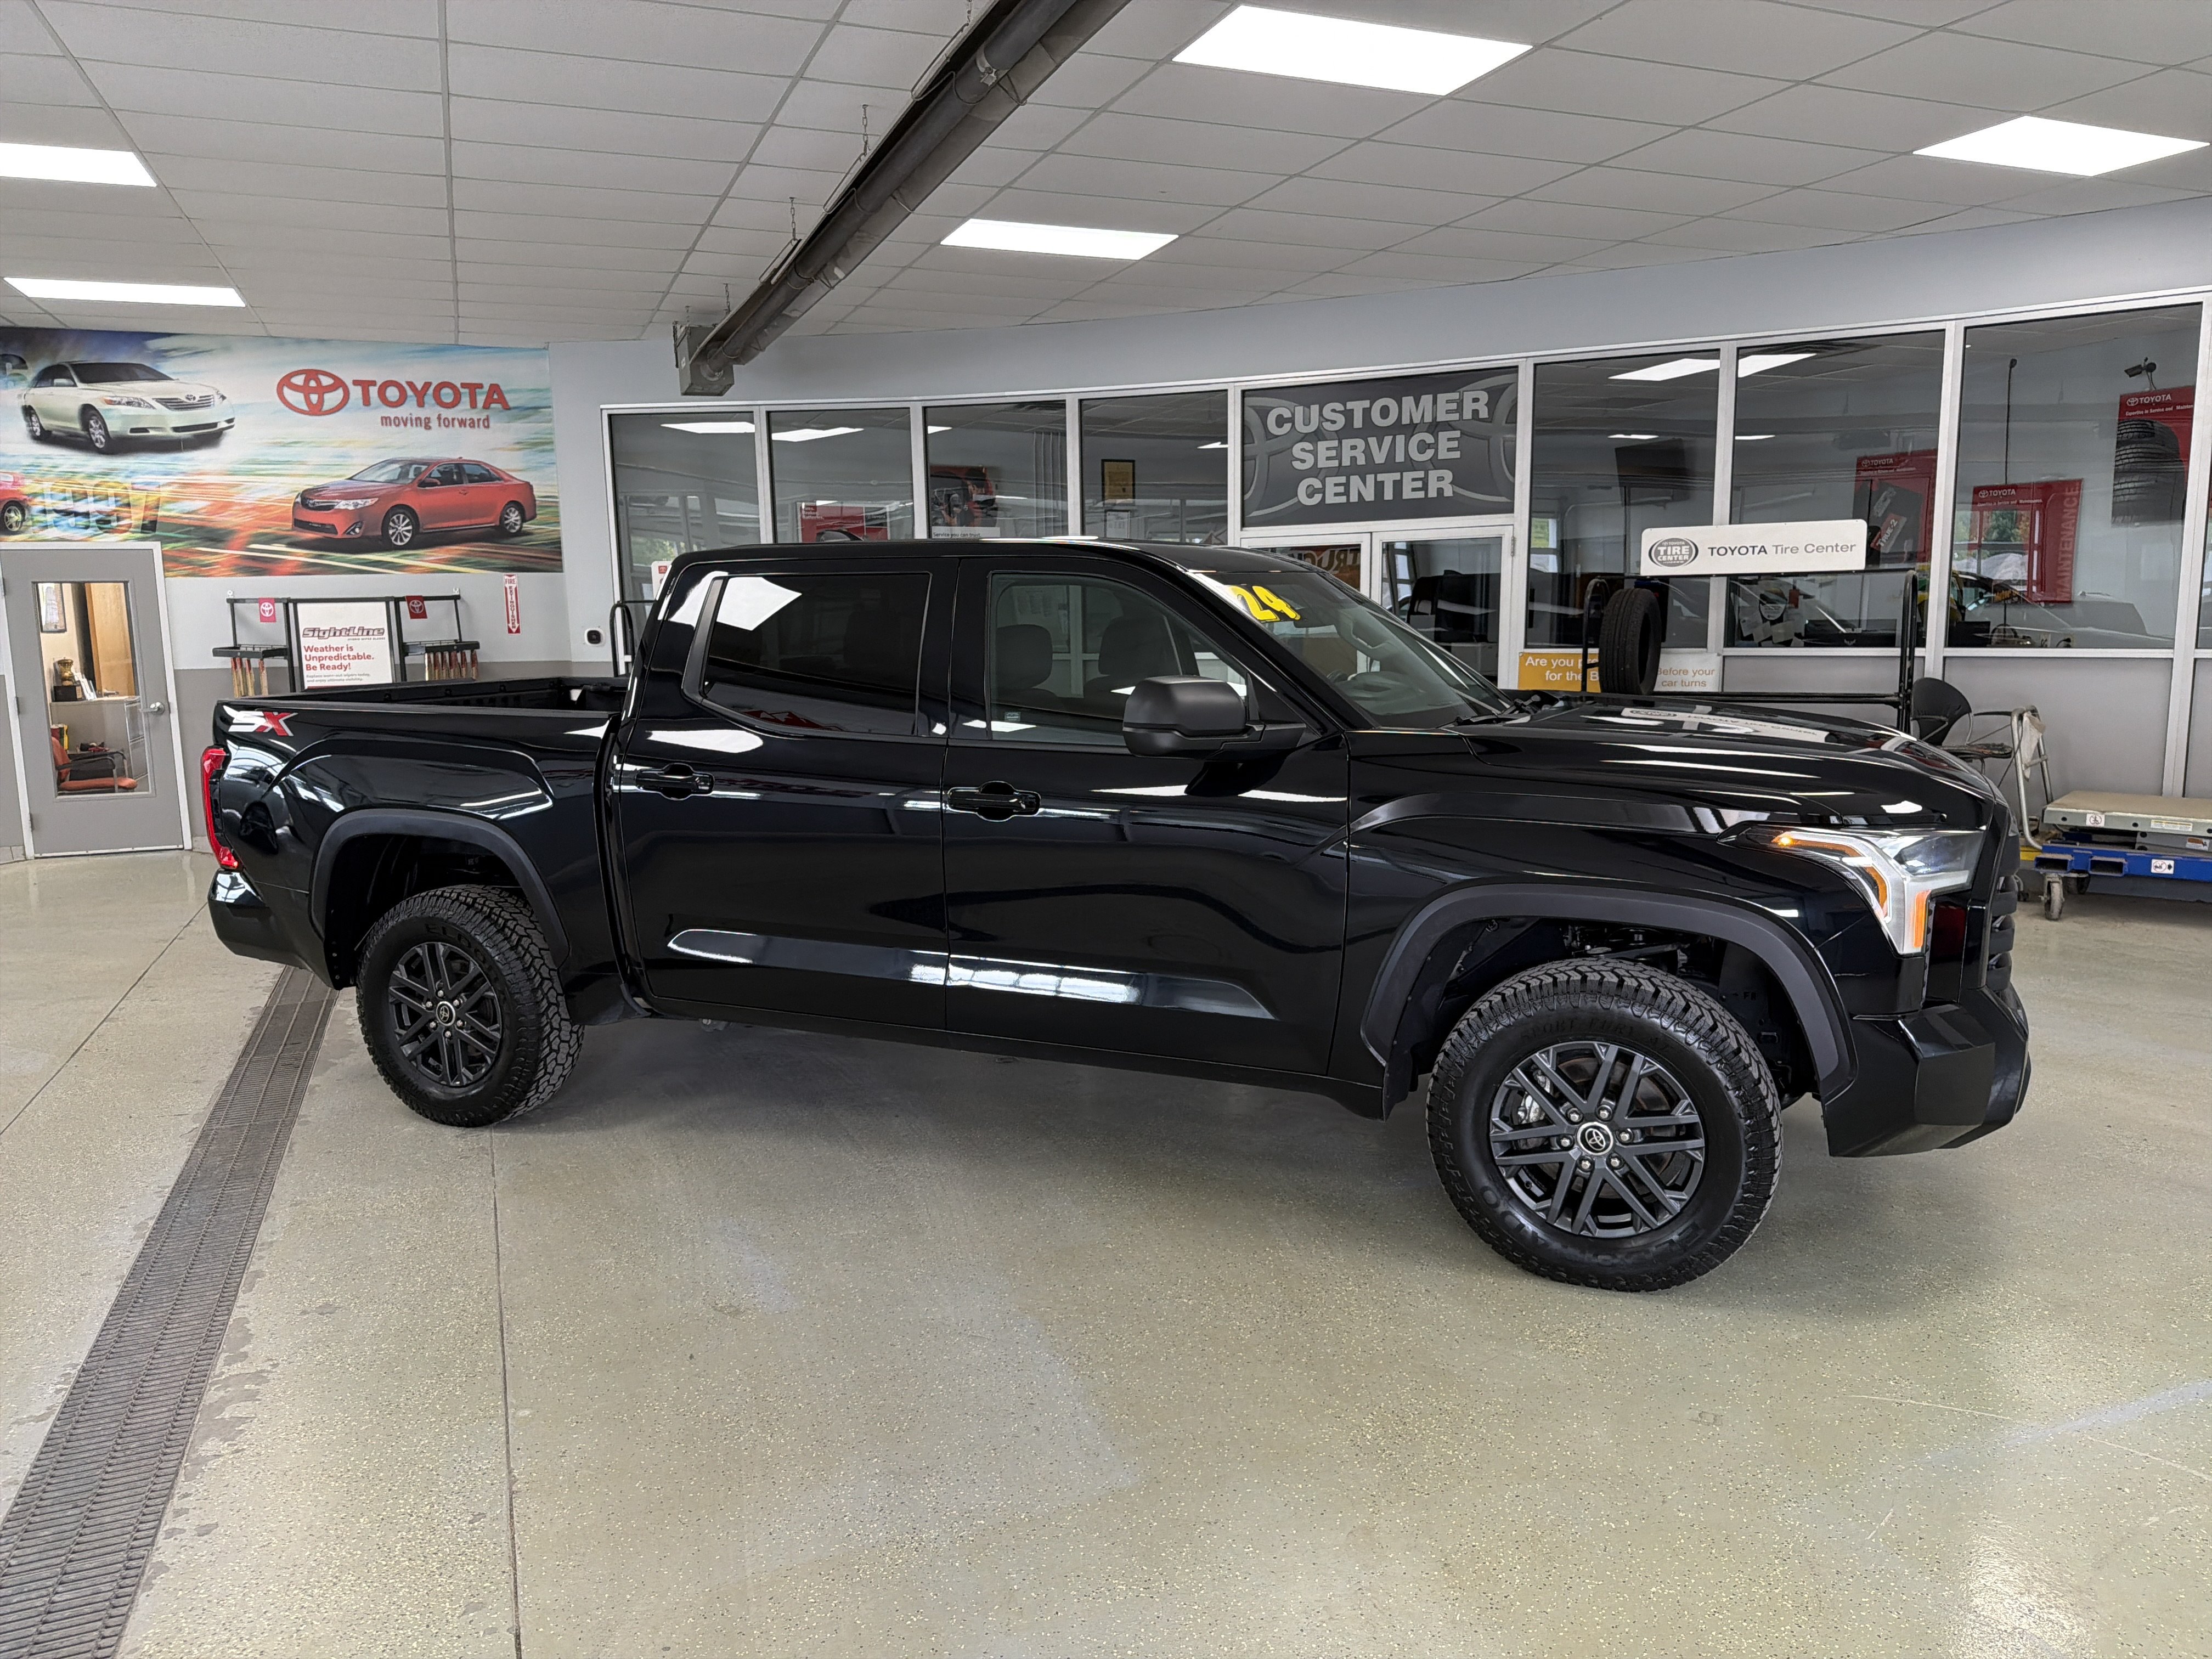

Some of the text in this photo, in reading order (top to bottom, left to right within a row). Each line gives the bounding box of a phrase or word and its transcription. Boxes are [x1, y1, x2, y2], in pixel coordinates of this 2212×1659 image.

[352, 379, 511, 410] TOYOTA
[2140, 394, 2171, 404] TOYOTA
[1266, 390, 1489, 436] CUSTOMER
[381, 413, 490, 430] moving forward
[1291, 430, 1461, 470] SERVICE
[1297, 469, 1453, 506] CENTER
[1657, 545, 1690, 555] TIRE
[1708, 542, 1857, 556] TOYOTA Tire Center
[1229, 586, 1301, 623] 24
[302, 627, 385, 640] SightLine
[303, 645, 344, 653] Weather
[304, 652, 374, 663] Unpredictable.
[1525, 656, 1547, 666] Are
[1551, 658, 1574, 669] you
[320, 662, 351, 672] Ready!
[1692, 669, 1714, 677] your
[1545, 670, 1562, 680] for
